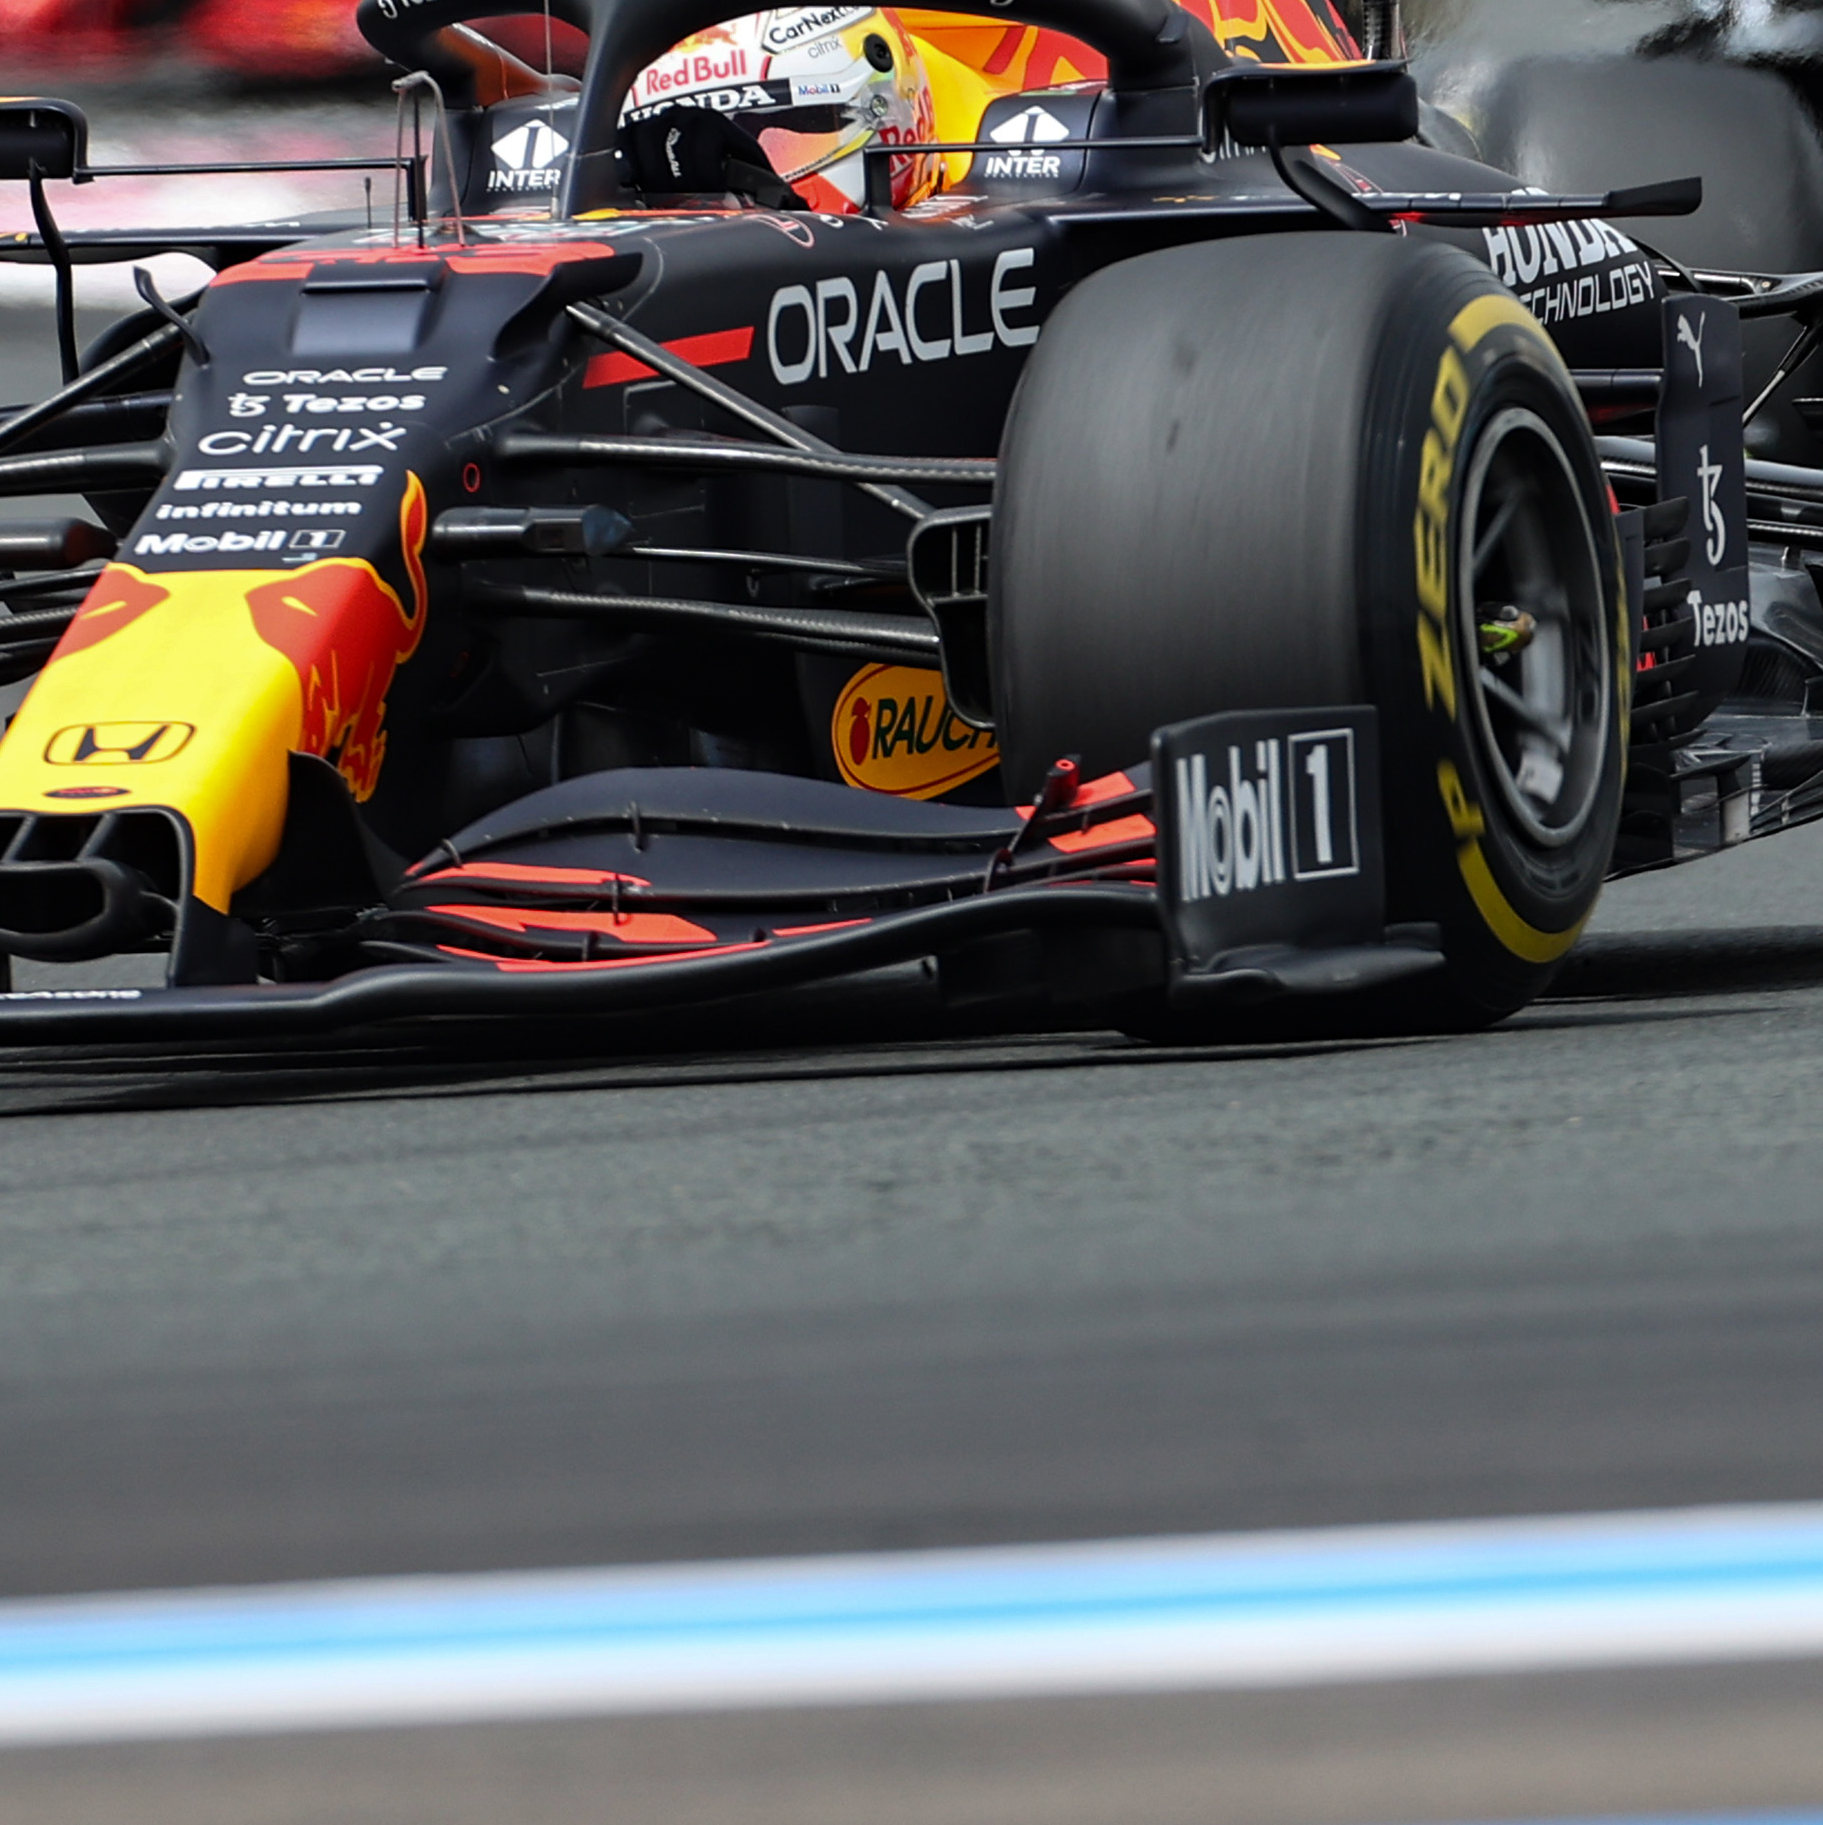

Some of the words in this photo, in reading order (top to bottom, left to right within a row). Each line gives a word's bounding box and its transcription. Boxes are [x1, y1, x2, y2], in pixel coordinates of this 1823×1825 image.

[807, 35, 844, 59] citrix
[646, 58, 690, 95] Red
[693, 49, 747, 82] Bull
[487, 168, 561, 189] INTER
[985, 156, 1061, 175] INTER
[767, 247, 1040, 385] ORACLE
[243, 366, 448, 385] ORACLE
[282, 393, 426, 414] Tezos
[197, 422, 407, 456] citrix
[173, 464, 384, 490] PIRELLI
[155, 500, 362, 520] infinitum
[134, 530, 288, 555] Mobil
[1413, 345, 1469, 723] ZERO
[1686, 589, 1749, 647] Tezos
[1437, 757, 1485, 835] P
[1176, 738, 1286, 903] Mobil
